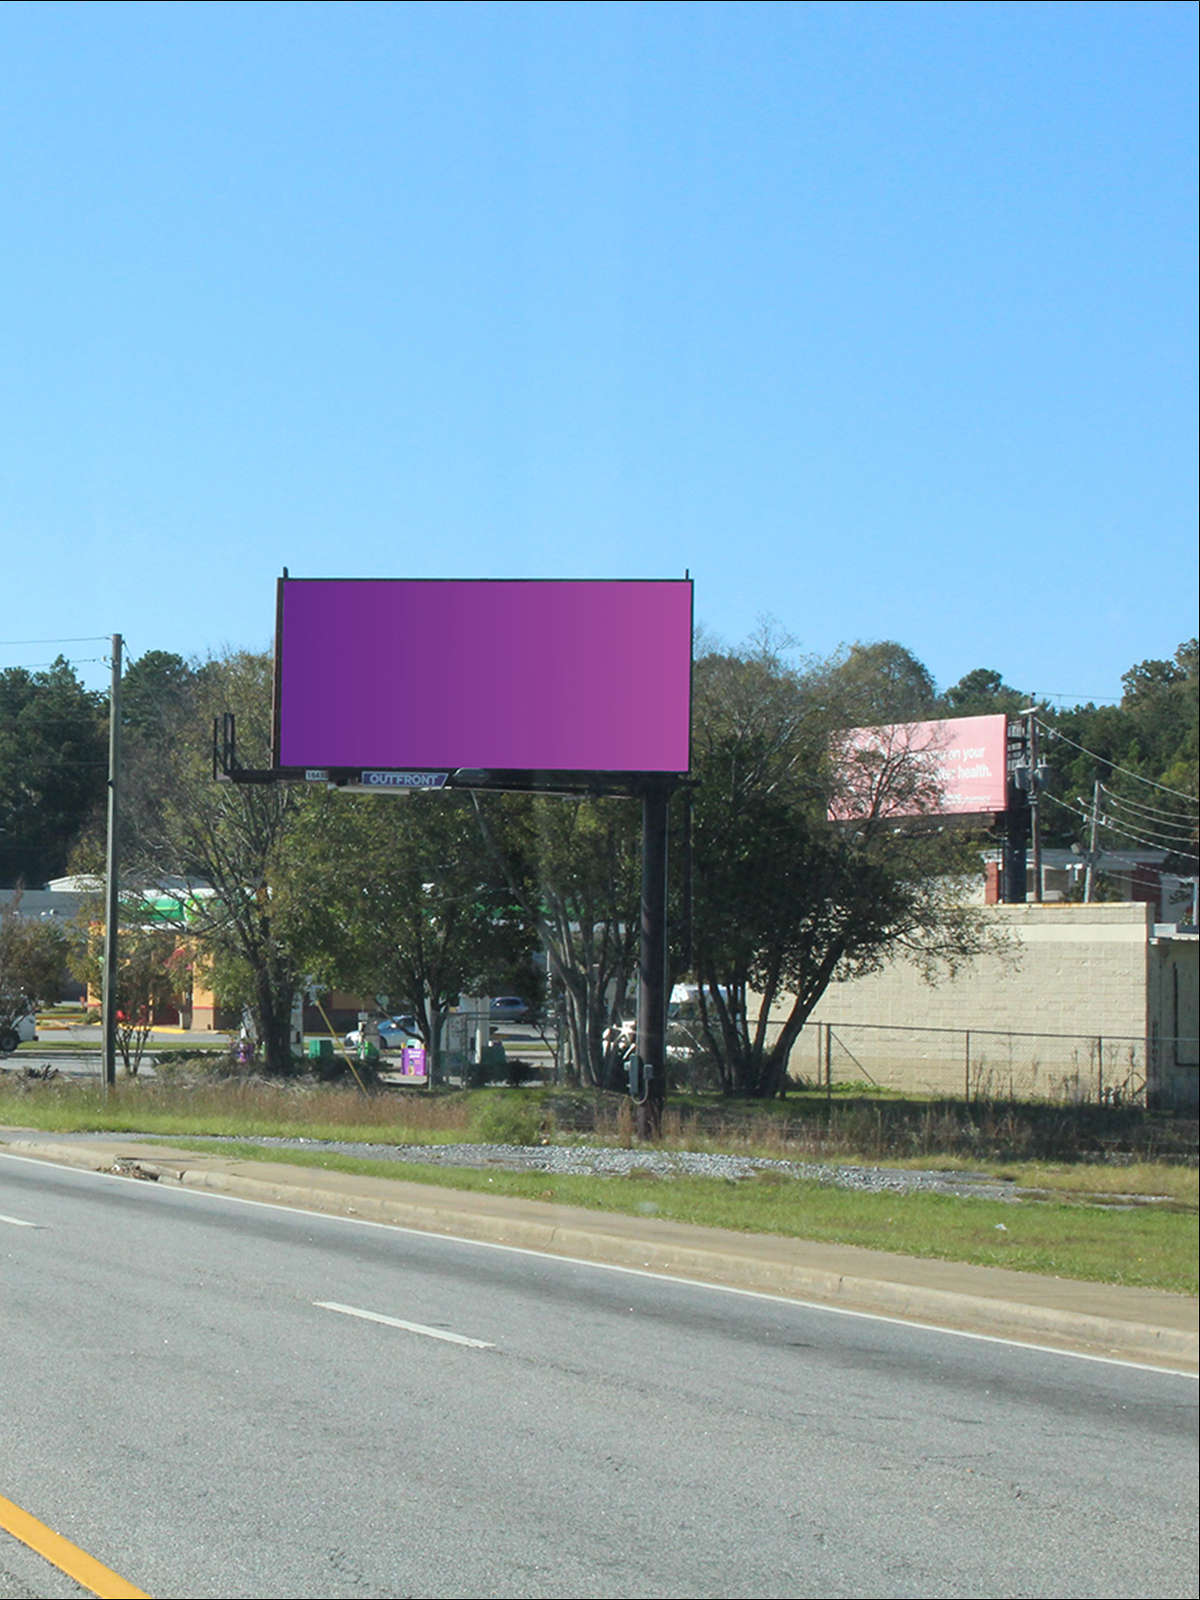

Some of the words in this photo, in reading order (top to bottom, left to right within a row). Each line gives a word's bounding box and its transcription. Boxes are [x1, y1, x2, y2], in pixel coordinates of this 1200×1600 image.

[963, 747, 985, 762] your
[369, 773, 438, 785] OUTFRONT
[958, 764, 992, 779] health.
